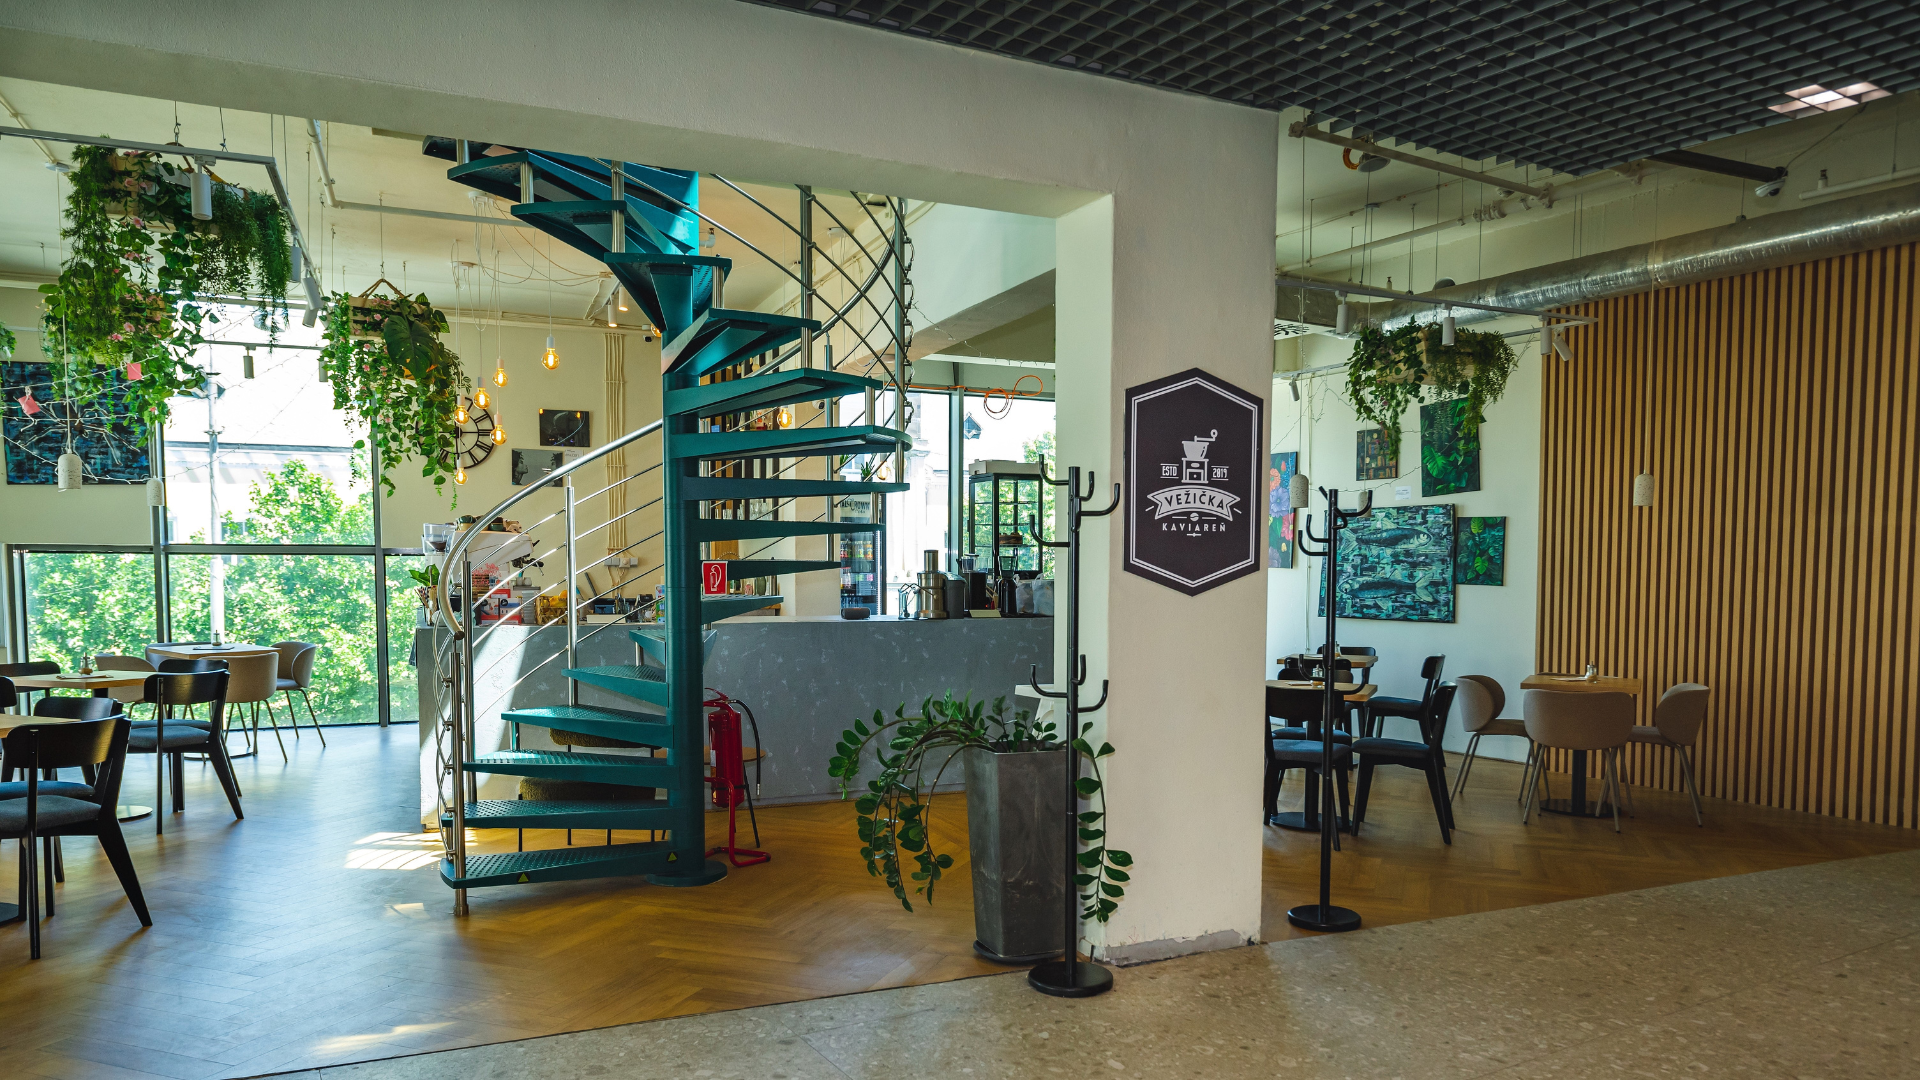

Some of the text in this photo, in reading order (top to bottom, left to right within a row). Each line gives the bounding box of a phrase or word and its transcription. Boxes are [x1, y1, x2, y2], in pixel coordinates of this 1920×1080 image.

[1162, 465, 1178, 477] ESTD
[1164, 490, 1224, 510] VEŽIČKA
[1162, 522, 1226, 532] KAVIAREŇ
